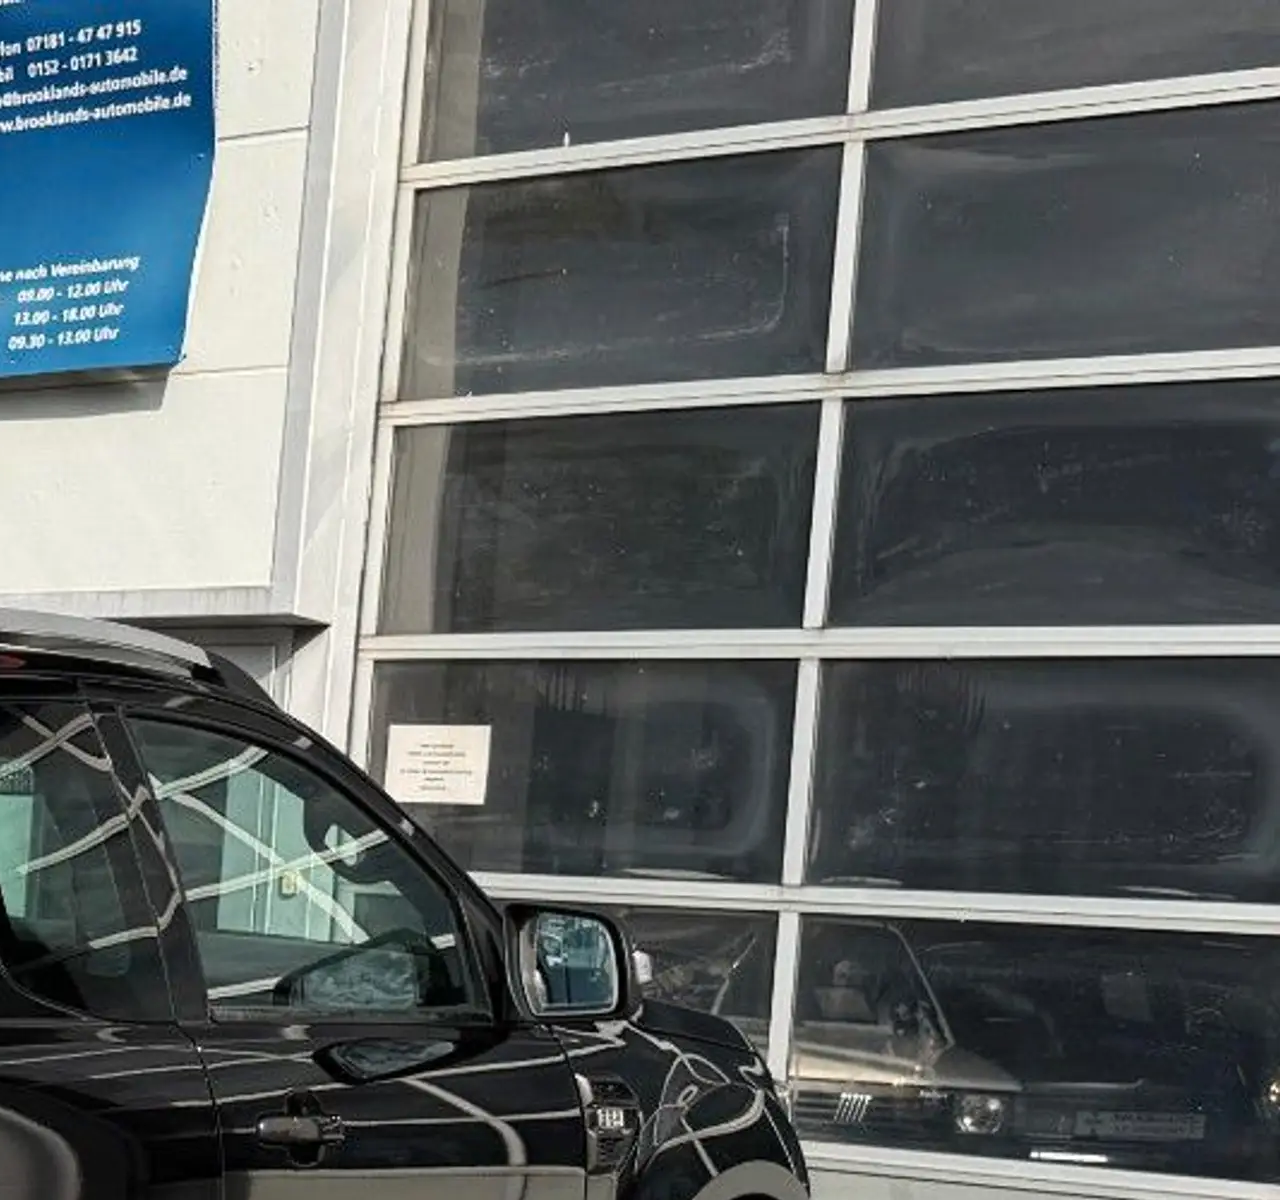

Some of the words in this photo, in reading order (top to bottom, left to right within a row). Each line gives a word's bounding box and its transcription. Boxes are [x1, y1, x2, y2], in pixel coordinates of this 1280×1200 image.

[27, 31, 65, 53] 07181
[77, 28, 94, 44] 47
[96, 24, 114, 40] 47
[116, 19, 142, 37] 915
[28, 59, 60, 78] 0152
[70, 53, 102, 71] 0171
[105, 47, 138, 67] 3642
[15, 265, 48, 281] nach
[51, 256, 141, 277] Vereinbarung
[104, 278, 130, 293] Uhr
[99, 302, 124, 318] Uhr
[93, 326, 120, 341] Uhr
